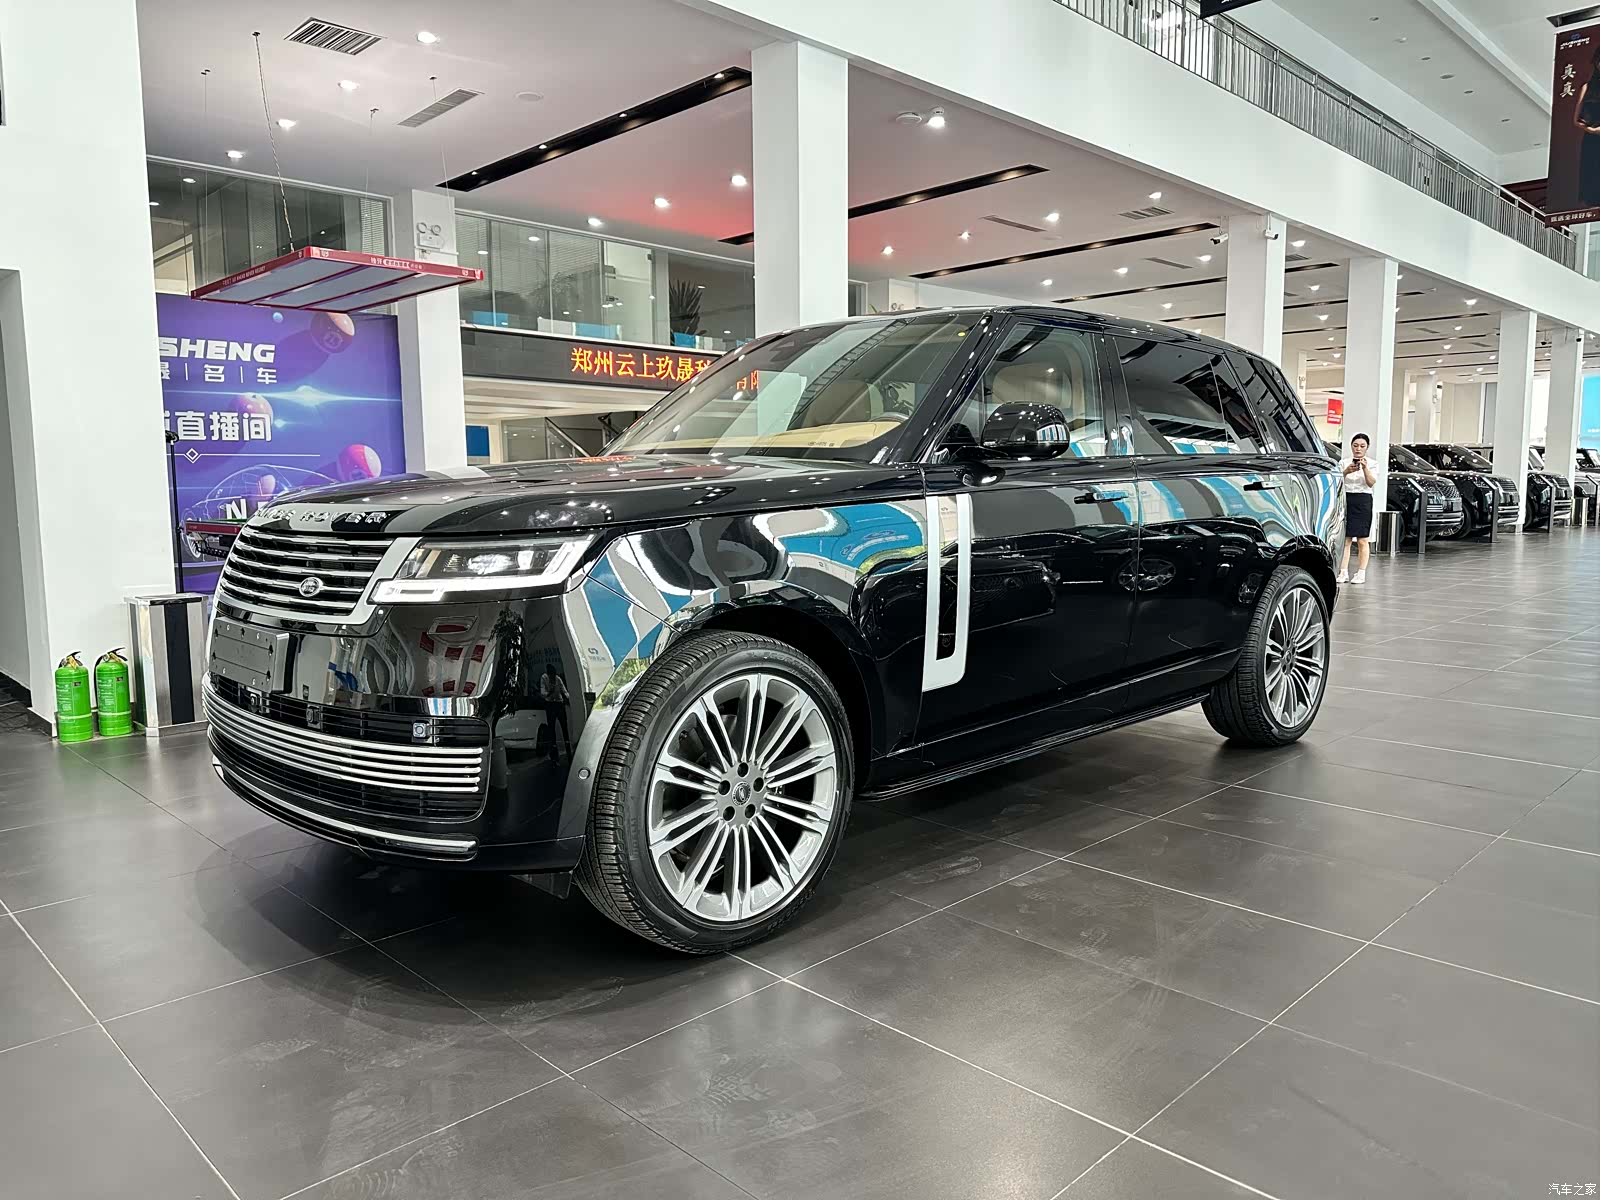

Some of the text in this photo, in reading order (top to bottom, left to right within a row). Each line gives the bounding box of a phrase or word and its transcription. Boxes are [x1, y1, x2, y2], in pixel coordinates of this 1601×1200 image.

[159, 337, 275, 363] SHENG
[164, 410, 272, 442] 直播间
